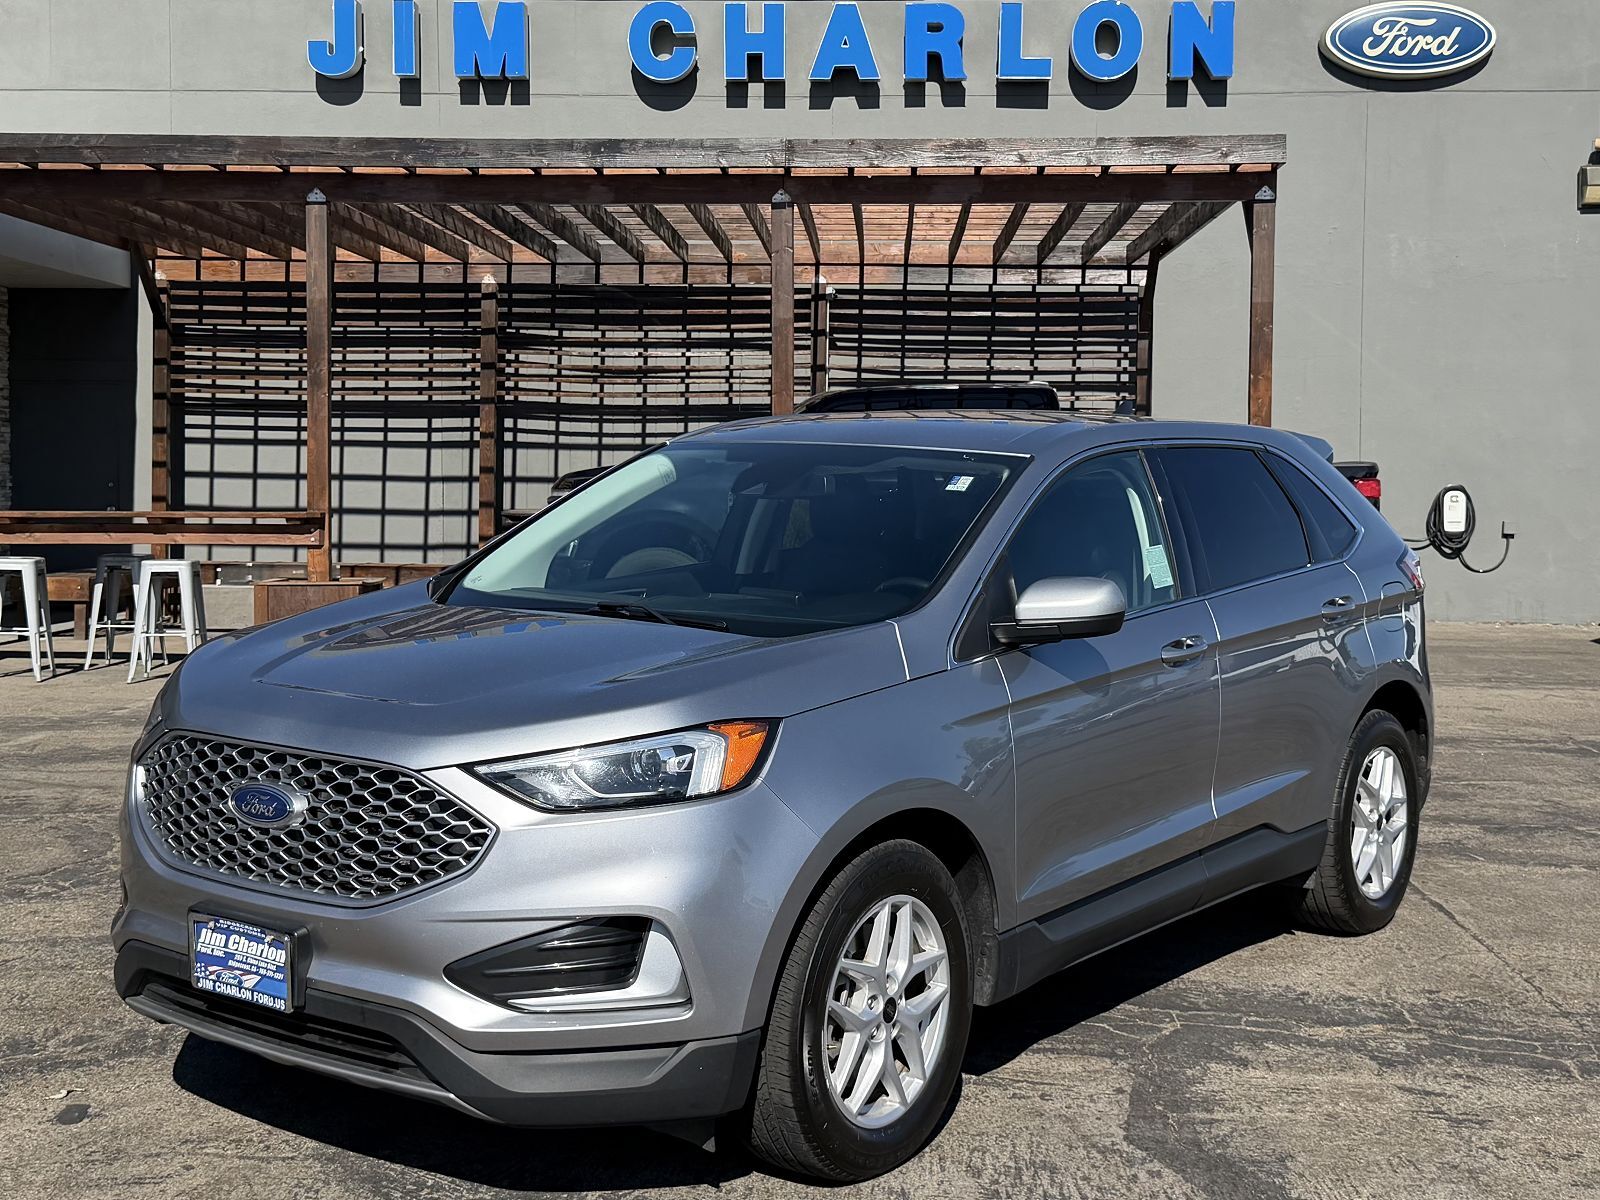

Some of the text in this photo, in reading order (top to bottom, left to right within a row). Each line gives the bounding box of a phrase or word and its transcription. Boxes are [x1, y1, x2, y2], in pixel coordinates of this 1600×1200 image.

[306, 0, 1235, 82] JIM CHARLON
[1362, 16, 1462, 57] Ford
[242, 792, 277, 817] Ford
[199, 928, 286, 963] Jim Charlon
[198, 977, 214, 991] JIM
[215, 982, 252, 1000] CHARLON
